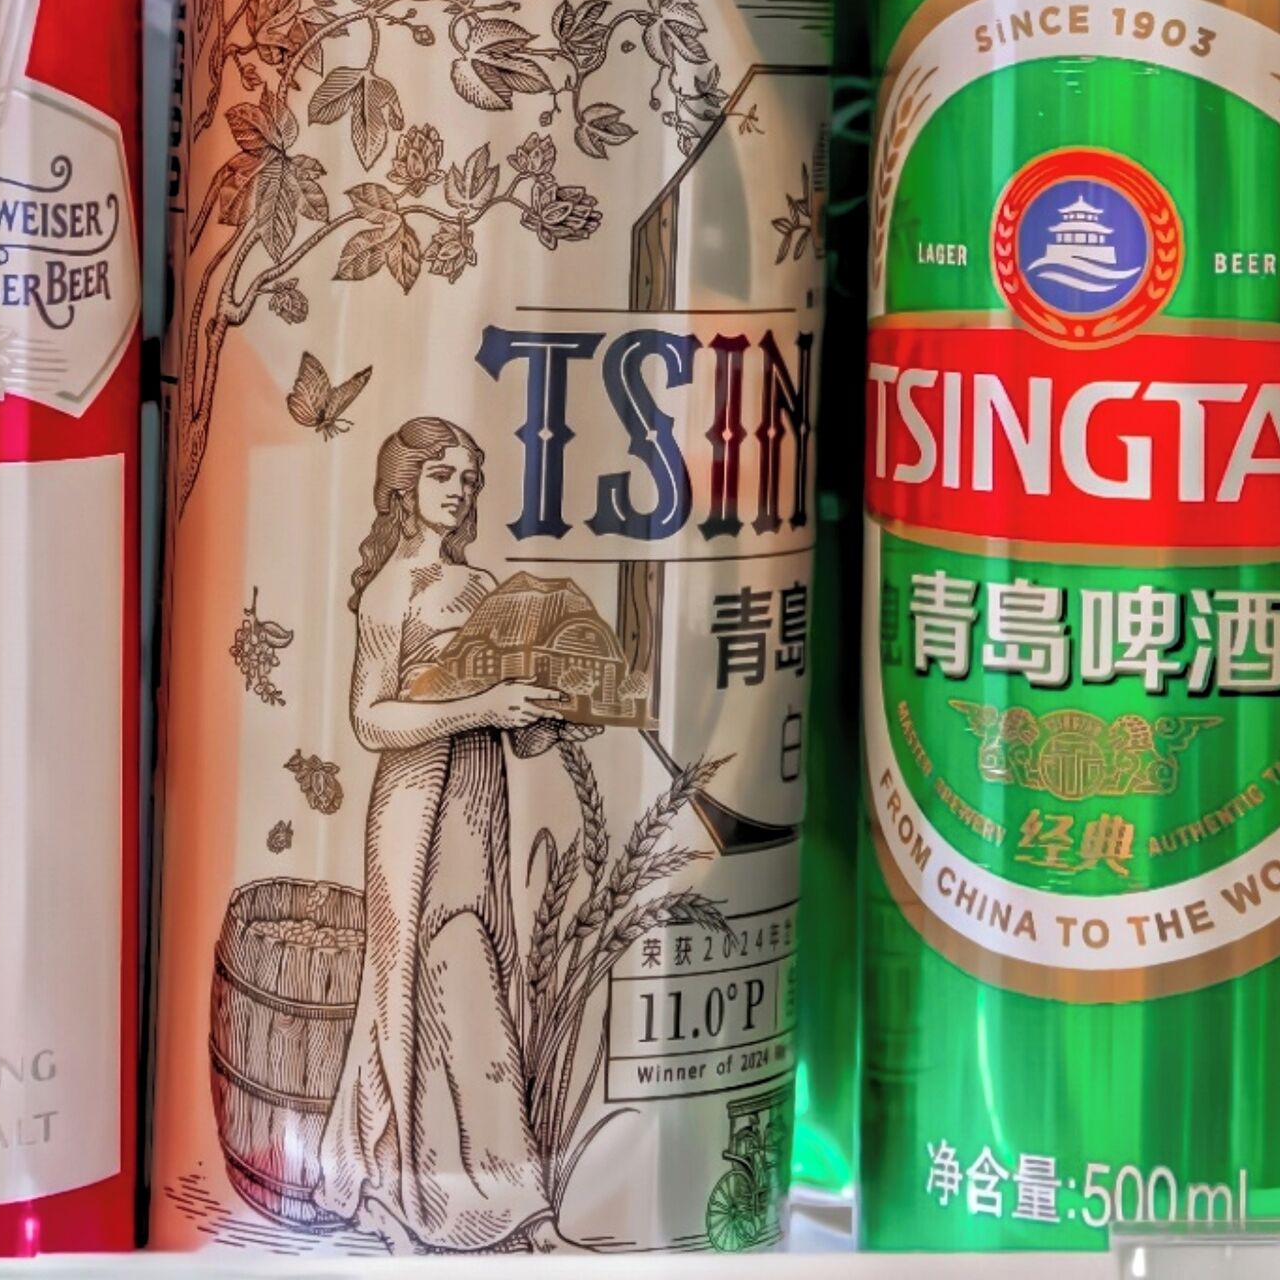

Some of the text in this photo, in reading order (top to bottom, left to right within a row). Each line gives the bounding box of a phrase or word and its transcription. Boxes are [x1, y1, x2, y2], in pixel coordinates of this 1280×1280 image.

[974, 4, 1217, 58] SINCE 1903
[46, 260, 111, 306] BEER
[918, 241, 1277, 277] LAGER BEER
[1014, 808, 1135, 877] 经典
[1148, 784, 1266, 857] AUTHENTIC
[879, 768, 933, 873] FROM
[936, 866, 1039, 942] CHINA
[1056, 916, 1111, 950] TO
[1127, 900, 1215, 948] THE
[638, 978, 765, 1043] 11.0°P
[637, 1062, 707, 1085] Winner
[716, 1054, 734, 1074] of
[740, 1047, 769, 1072] 2024
